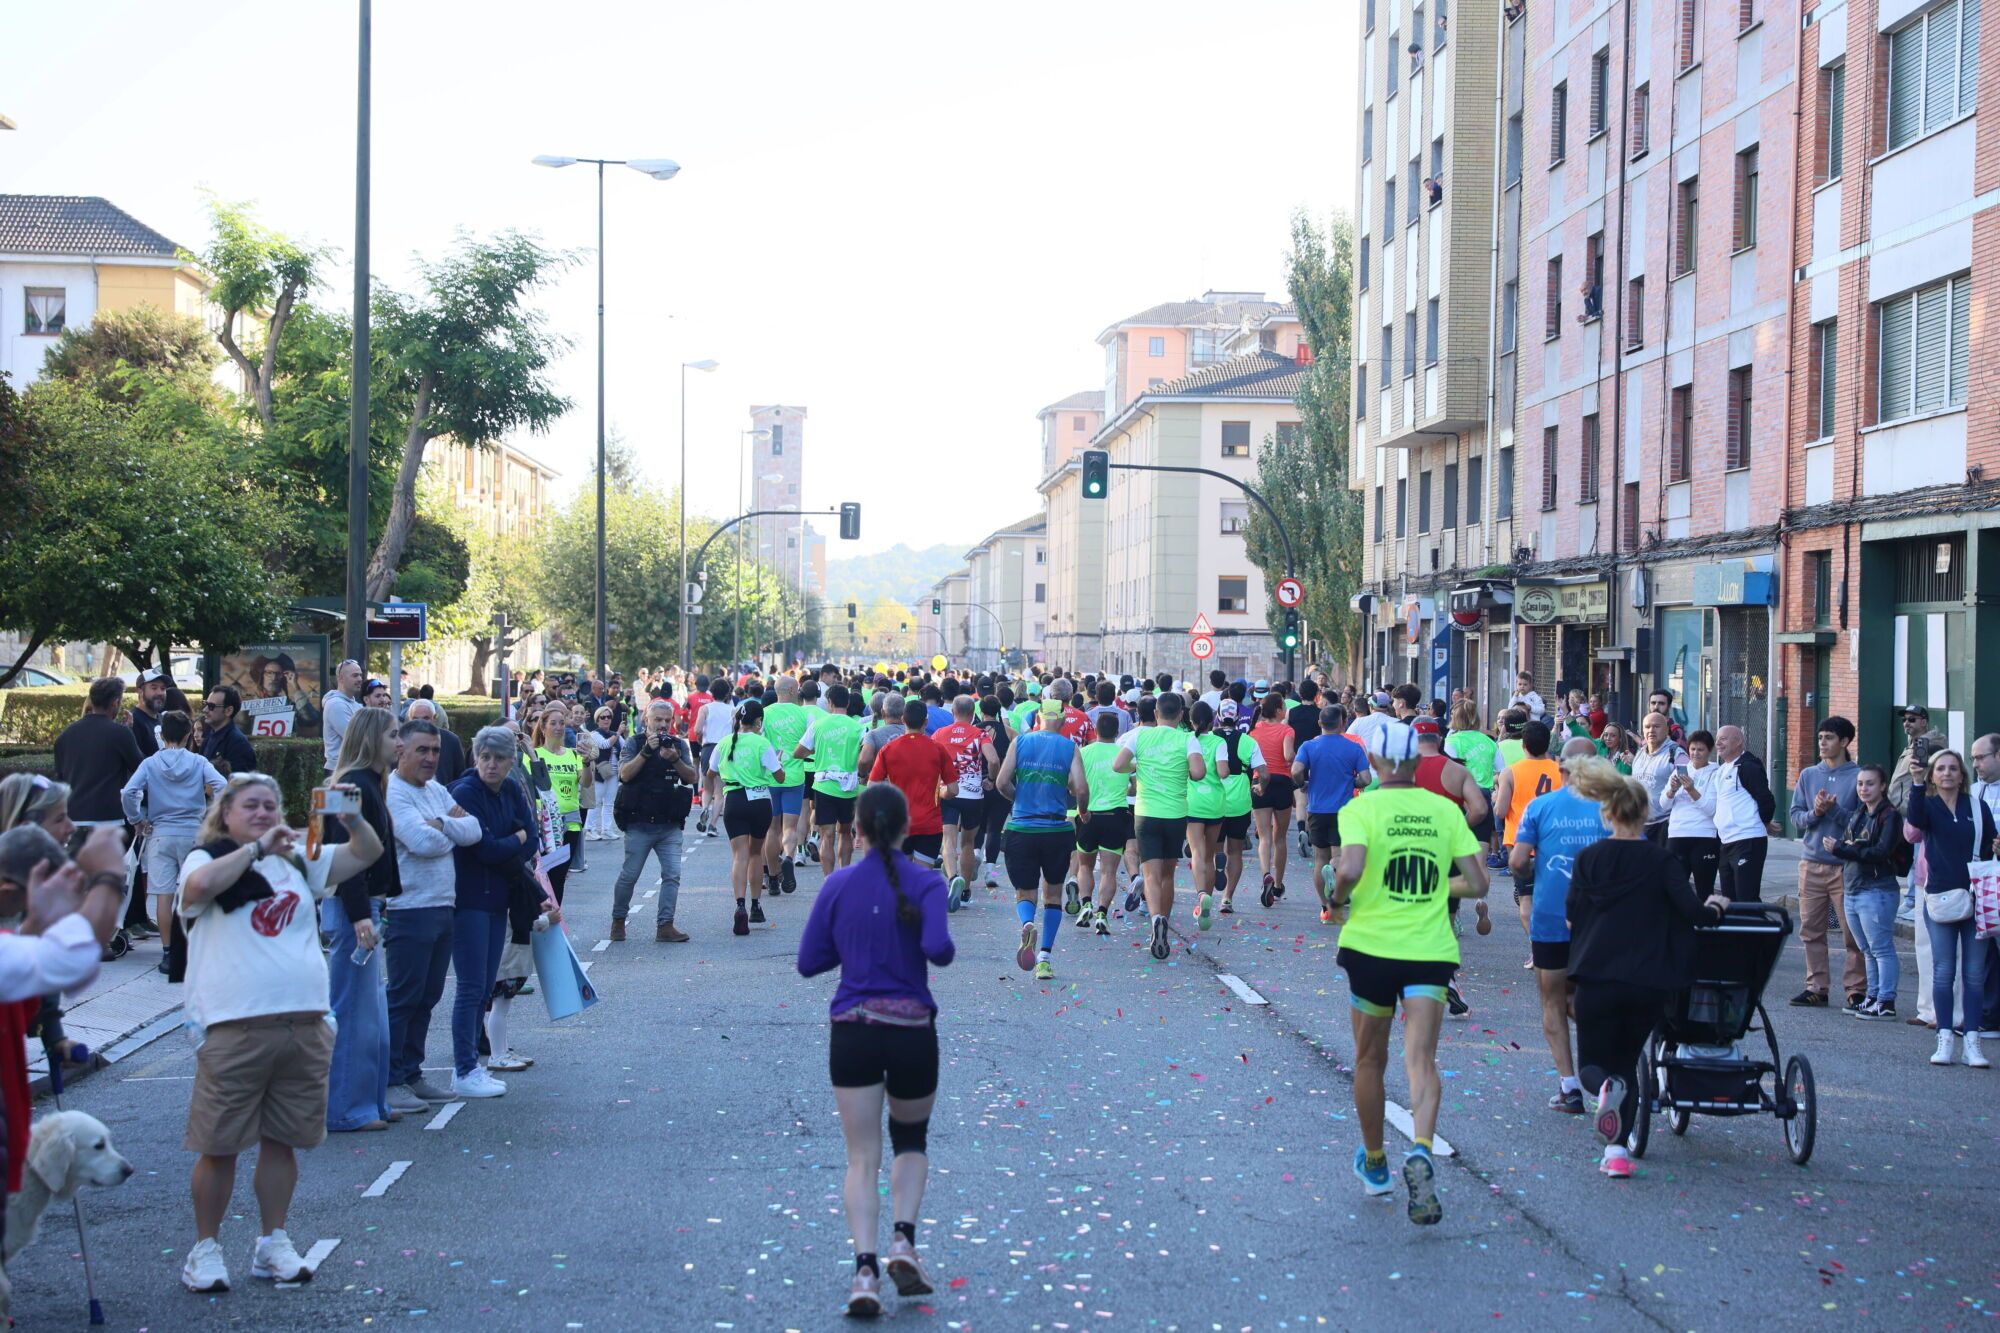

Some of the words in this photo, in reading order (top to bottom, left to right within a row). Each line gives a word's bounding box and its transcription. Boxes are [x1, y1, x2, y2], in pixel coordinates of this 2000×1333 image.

[1196, 643, 1208, 651] 30
[243, 700, 262, 709] VER
[263, 697, 284, 708] BIEN
[257, 719, 286, 736] 50
[1394, 815, 1432, 824] CIERRE
[1387, 828, 1438, 838] CARRERA
